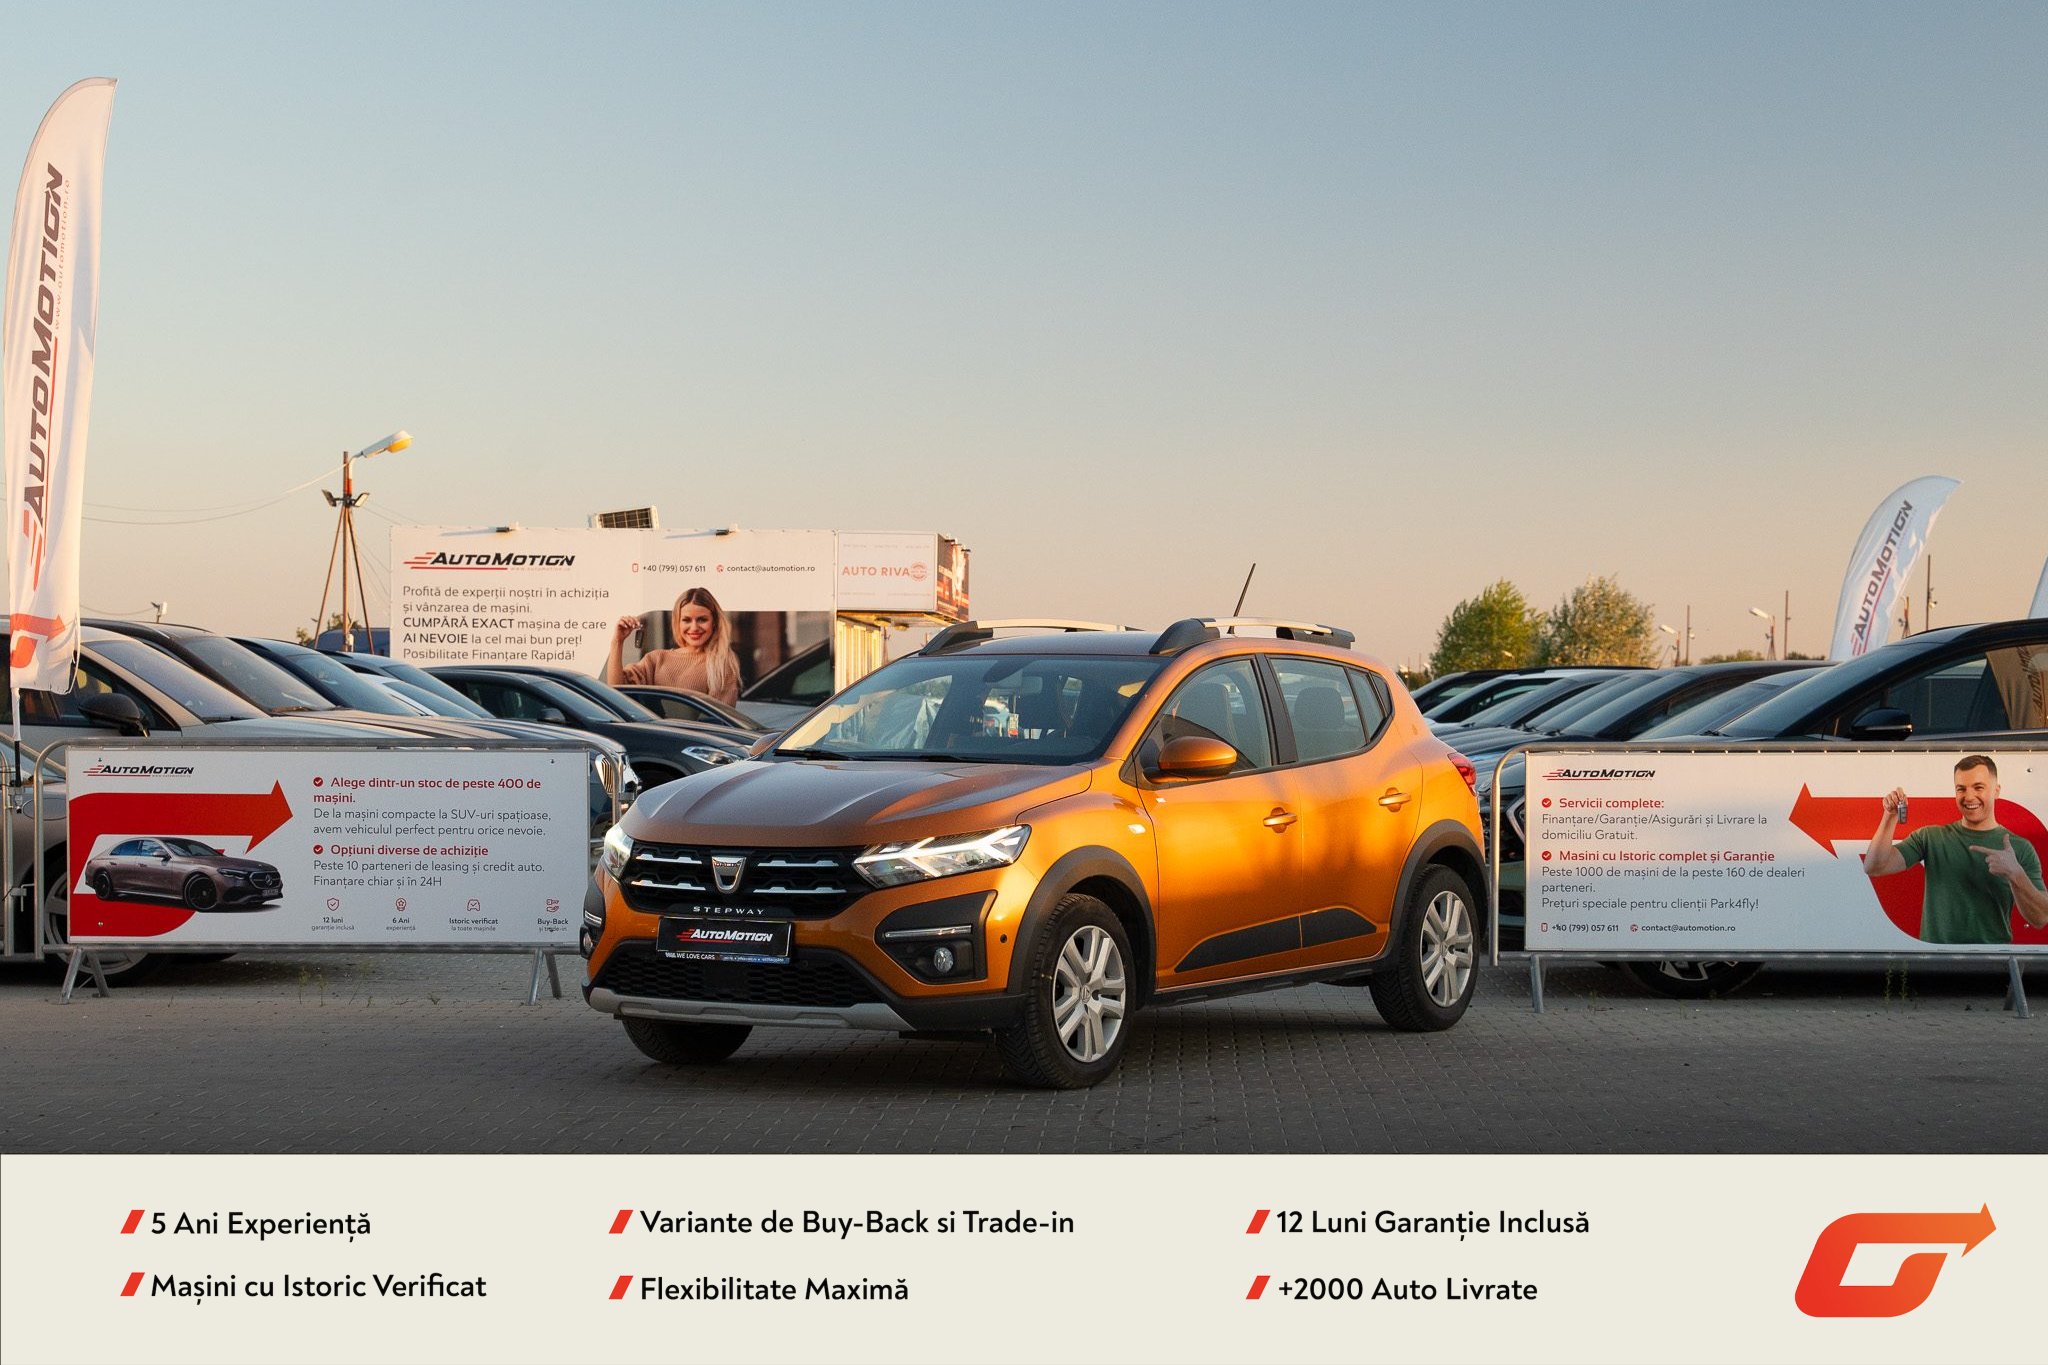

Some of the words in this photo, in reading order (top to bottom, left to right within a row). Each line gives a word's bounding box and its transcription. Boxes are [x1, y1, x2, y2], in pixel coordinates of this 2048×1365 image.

[659, 564, 677, 573] (799)
[727, 565, 815, 573] contact@automotion.ro
[842, 566, 877, 576] AUTO
[881, 567, 910, 576] RIVA
[403, 586, 440, 597] Profită
[445, 587, 459, 597] de
[463, 588, 505, 598] experții
[510, 588, 542, 599] noștri
[546, 587, 556, 598] în
[560, 588, 609, 600] achiziția
[403, 603, 412, 613] și
[416, 601, 469, 612] vânzarea
[473, 603, 487, 612] de
[491, 604, 532, 615] mașini.
[403, 615, 468, 628] CUMPĂRĂ
[472, 618, 514, 629] EXACT
[518, 619, 560, 630] mașina
[564, 620, 578, 629] de
[403, 633, 416, 643] AI
[420, 633, 468, 643] NEVOIE
[472, 634, 481, 643] la
[485, 635, 501, 644] cel
[505, 635, 526, 644] mai
[531, 635, 552, 644] bun
[557, 635, 581, 646] preț!
[404, 648, 468, 659] Posibilitate
[472, 649, 527, 662] Finanțare
[532, 650, 574, 662] Rapidă!
[331, 777, 365, 789] Alege
[369, 778, 414, 787] dintr-un
[418, 780, 442, 788] stoc
[445, 778, 459, 788] de
[463, 780, 494, 790] peste
[498, 779, 523, 788] 400
[527, 779, 541, 788] de
[314, 793, 355, 805] mașini.
[1560, 798, 1602, 808] Servicii
[1606, 798, 1664, 810] complete:
[314, 808, 329, 818] De
[333, 808, 341, 818] la
[345, 809, 378, 821] mașini
[382, 811, 435, 821] compacte
[439, 808, 447, 819] la
[451, 809, 494, 819] SUV-uri
[498, 810, 551, 823] spațioase,
[1543, 814, 1702, 828] Finanțare/Garanție/Asigurări
[1706, 815, 1713, 827] și
[1717, 814, 1755, 824] Livrare
[1759, 814, 1767, 824] la
[314, 826, 342, 834] avem
[345, 824, 391, 834] vehiculul
[396, 824, 435, 837] perfect
[439, 826, 474, 837] pentru
[478, 826, 504, 835] orice
[508, 825, 546, 835] nevoie.
[1542, 829, 1591, 839] domiciliu
[1595, 829, 1638, 840] Gratuit.
[331, 845, 374, 857] Opțiuni
[378, 845, 420, 855] diverse
[423, 845, 437, 855] de
[441, 846, 488, 858] achiziție
[1560, 851, 1599, 860] Masini
[1620, 851, 1655, 861] Istoric
[1659, 851, 1707, 863] complet
[1711, 851, 1720, 863] și
[1723, 851, 1775, 864] Garanție
[314, 860, 343, 870] Peste
[347, 861, 358, 870] 10
[362, 861, 411, 873] parteneri
[415, 861, 428, 871] de
[432, 861, 468, 874] leasing
[473, 862, 480, 874] și
[483, 861, 515, 871] credit
[518, 863, 544, 872] auto.
[1542, 866, 1572, 877] Peste
[1576, 867, 1603, 876] 1000
[1607, 866, 1620, 876] de
[1624, 867, 1659, 880] mașini
[1662, 866, 1676, 877] de
[1680, 867, 1688, 877] la
[1692, 868, 1723, 880] peste
[1726, 867, 1745, 877] 160
[1749, 866, 1764, 877] de
[1767, 867, 1805, 877] dealeri
[314, 876, 364, 889] Finanțare
[368, 876, 394, 886] chiar
[397, 876, 404, 889] și
[407, 877, 416, 886] în
[420, 877, 441, 886] 24H
[1542, 883, 1595, 894] parteneri.
[693, 906, 765, 915] STEPWAY
[1542, 898, 1579, 912] Prețuri
[1583, 898, 1627, 910] speciale
[1631, 900, 1667, 911] pentru
[1671, 898, 1706, 912] clienții
[1711, 898, 1758, 911] Park4fly!
[537, 918, 569, 927] Buy-Back
[1569, 924, 1588, 932] (799)
[1642, 924, 1735, 932] contact@automotion.ro
